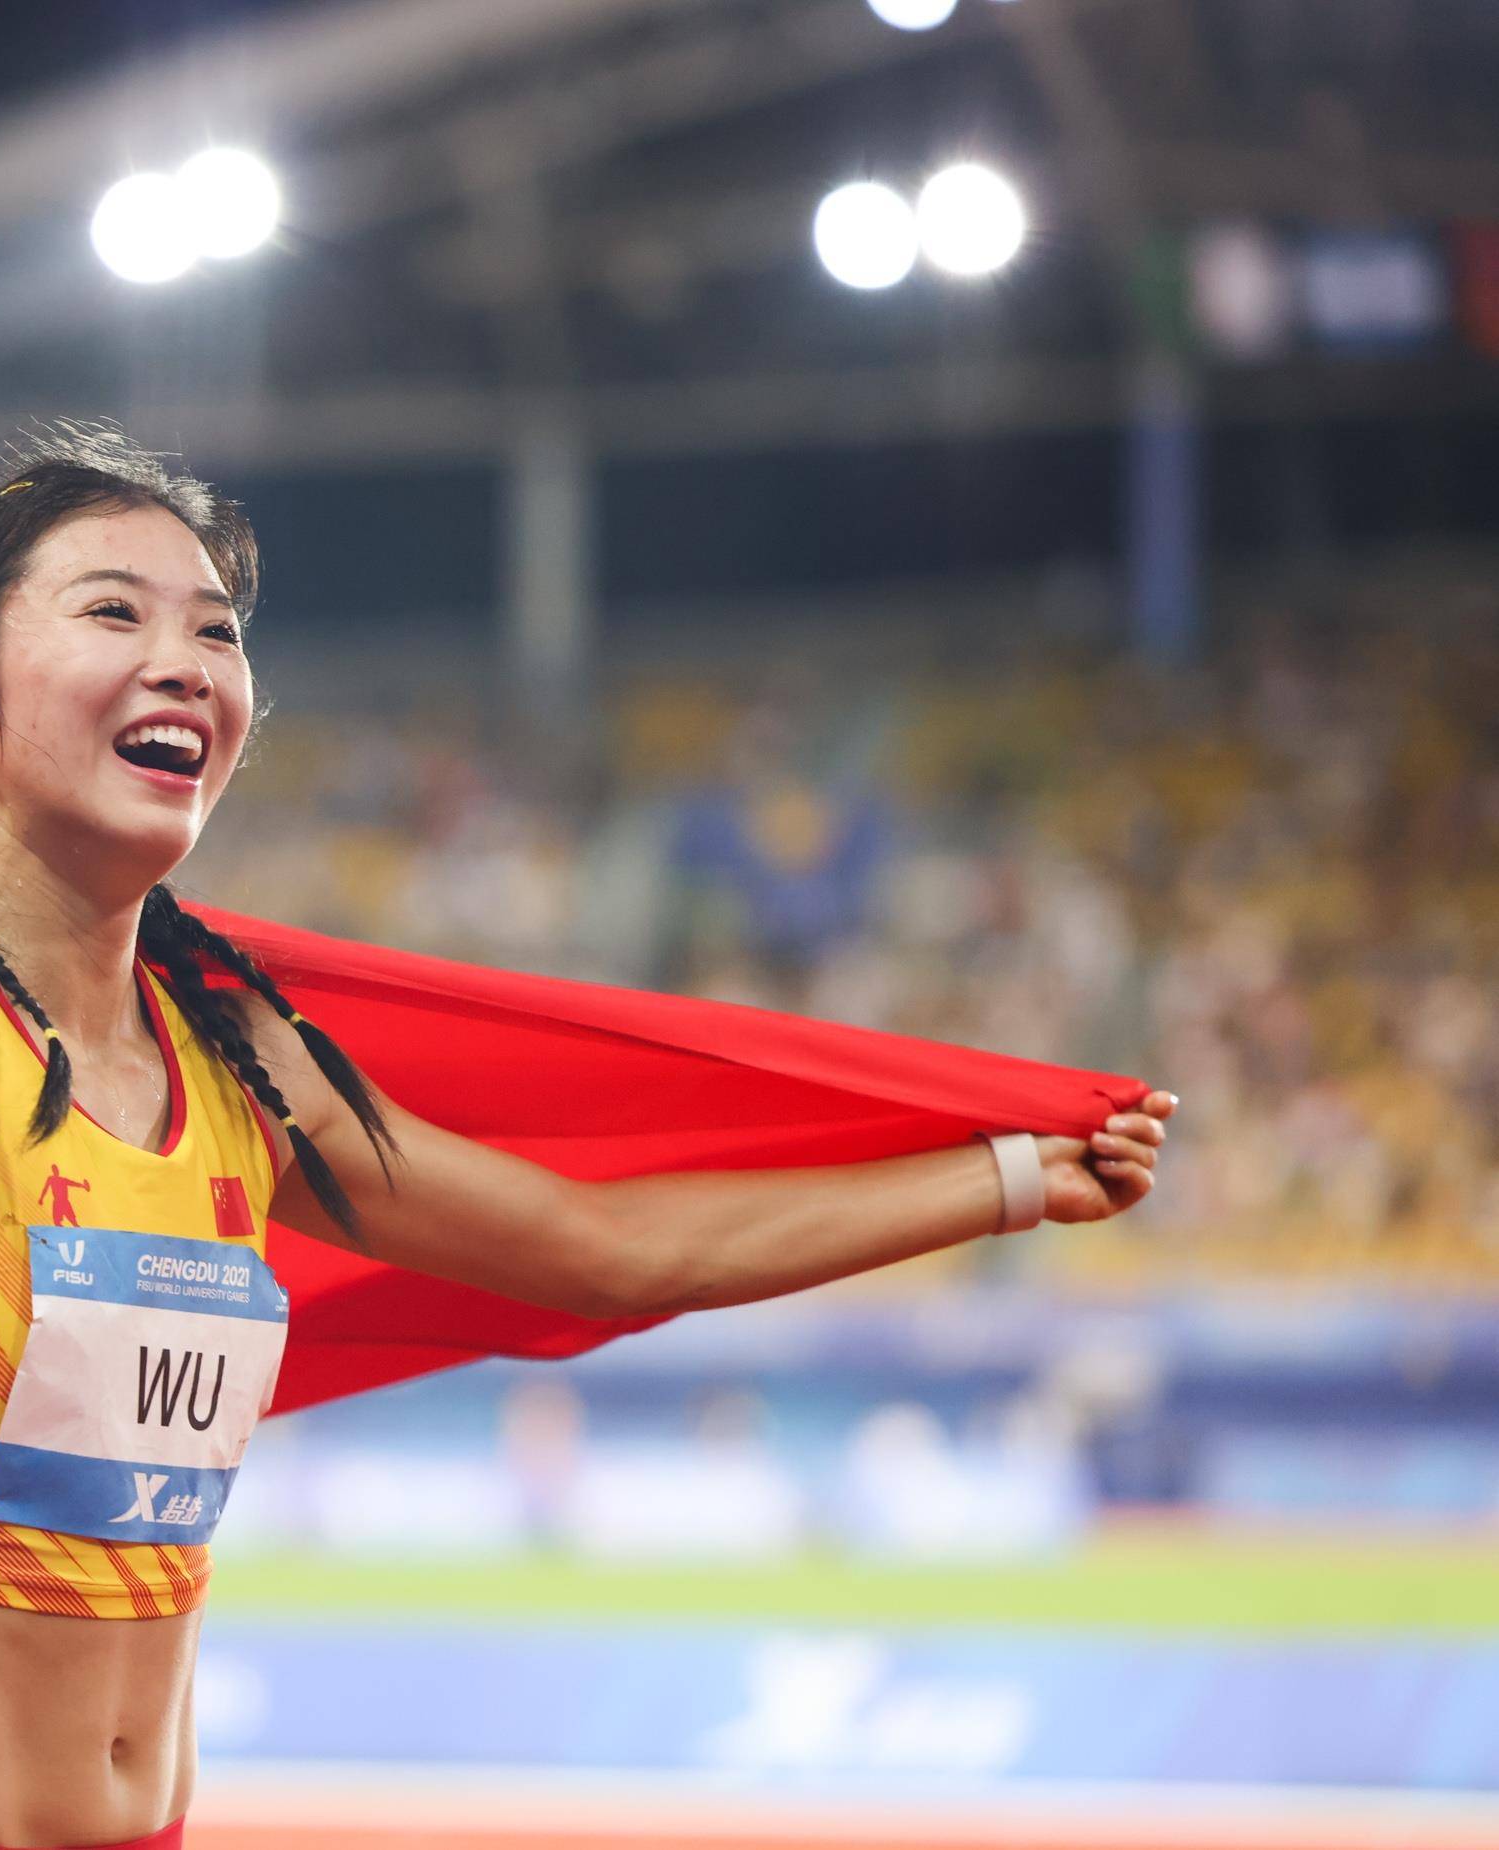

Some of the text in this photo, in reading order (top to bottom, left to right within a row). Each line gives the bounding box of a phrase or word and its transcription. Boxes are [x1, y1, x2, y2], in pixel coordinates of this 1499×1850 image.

[53, 1269, 94, 1286] FISU
[137, 1254, 250, 1288] CHENGDU 2021
[136, 1280, 251, 1304] FISU WORLD UNIVERSITY GAMES
[137, 1346, 225, 1431] WU
